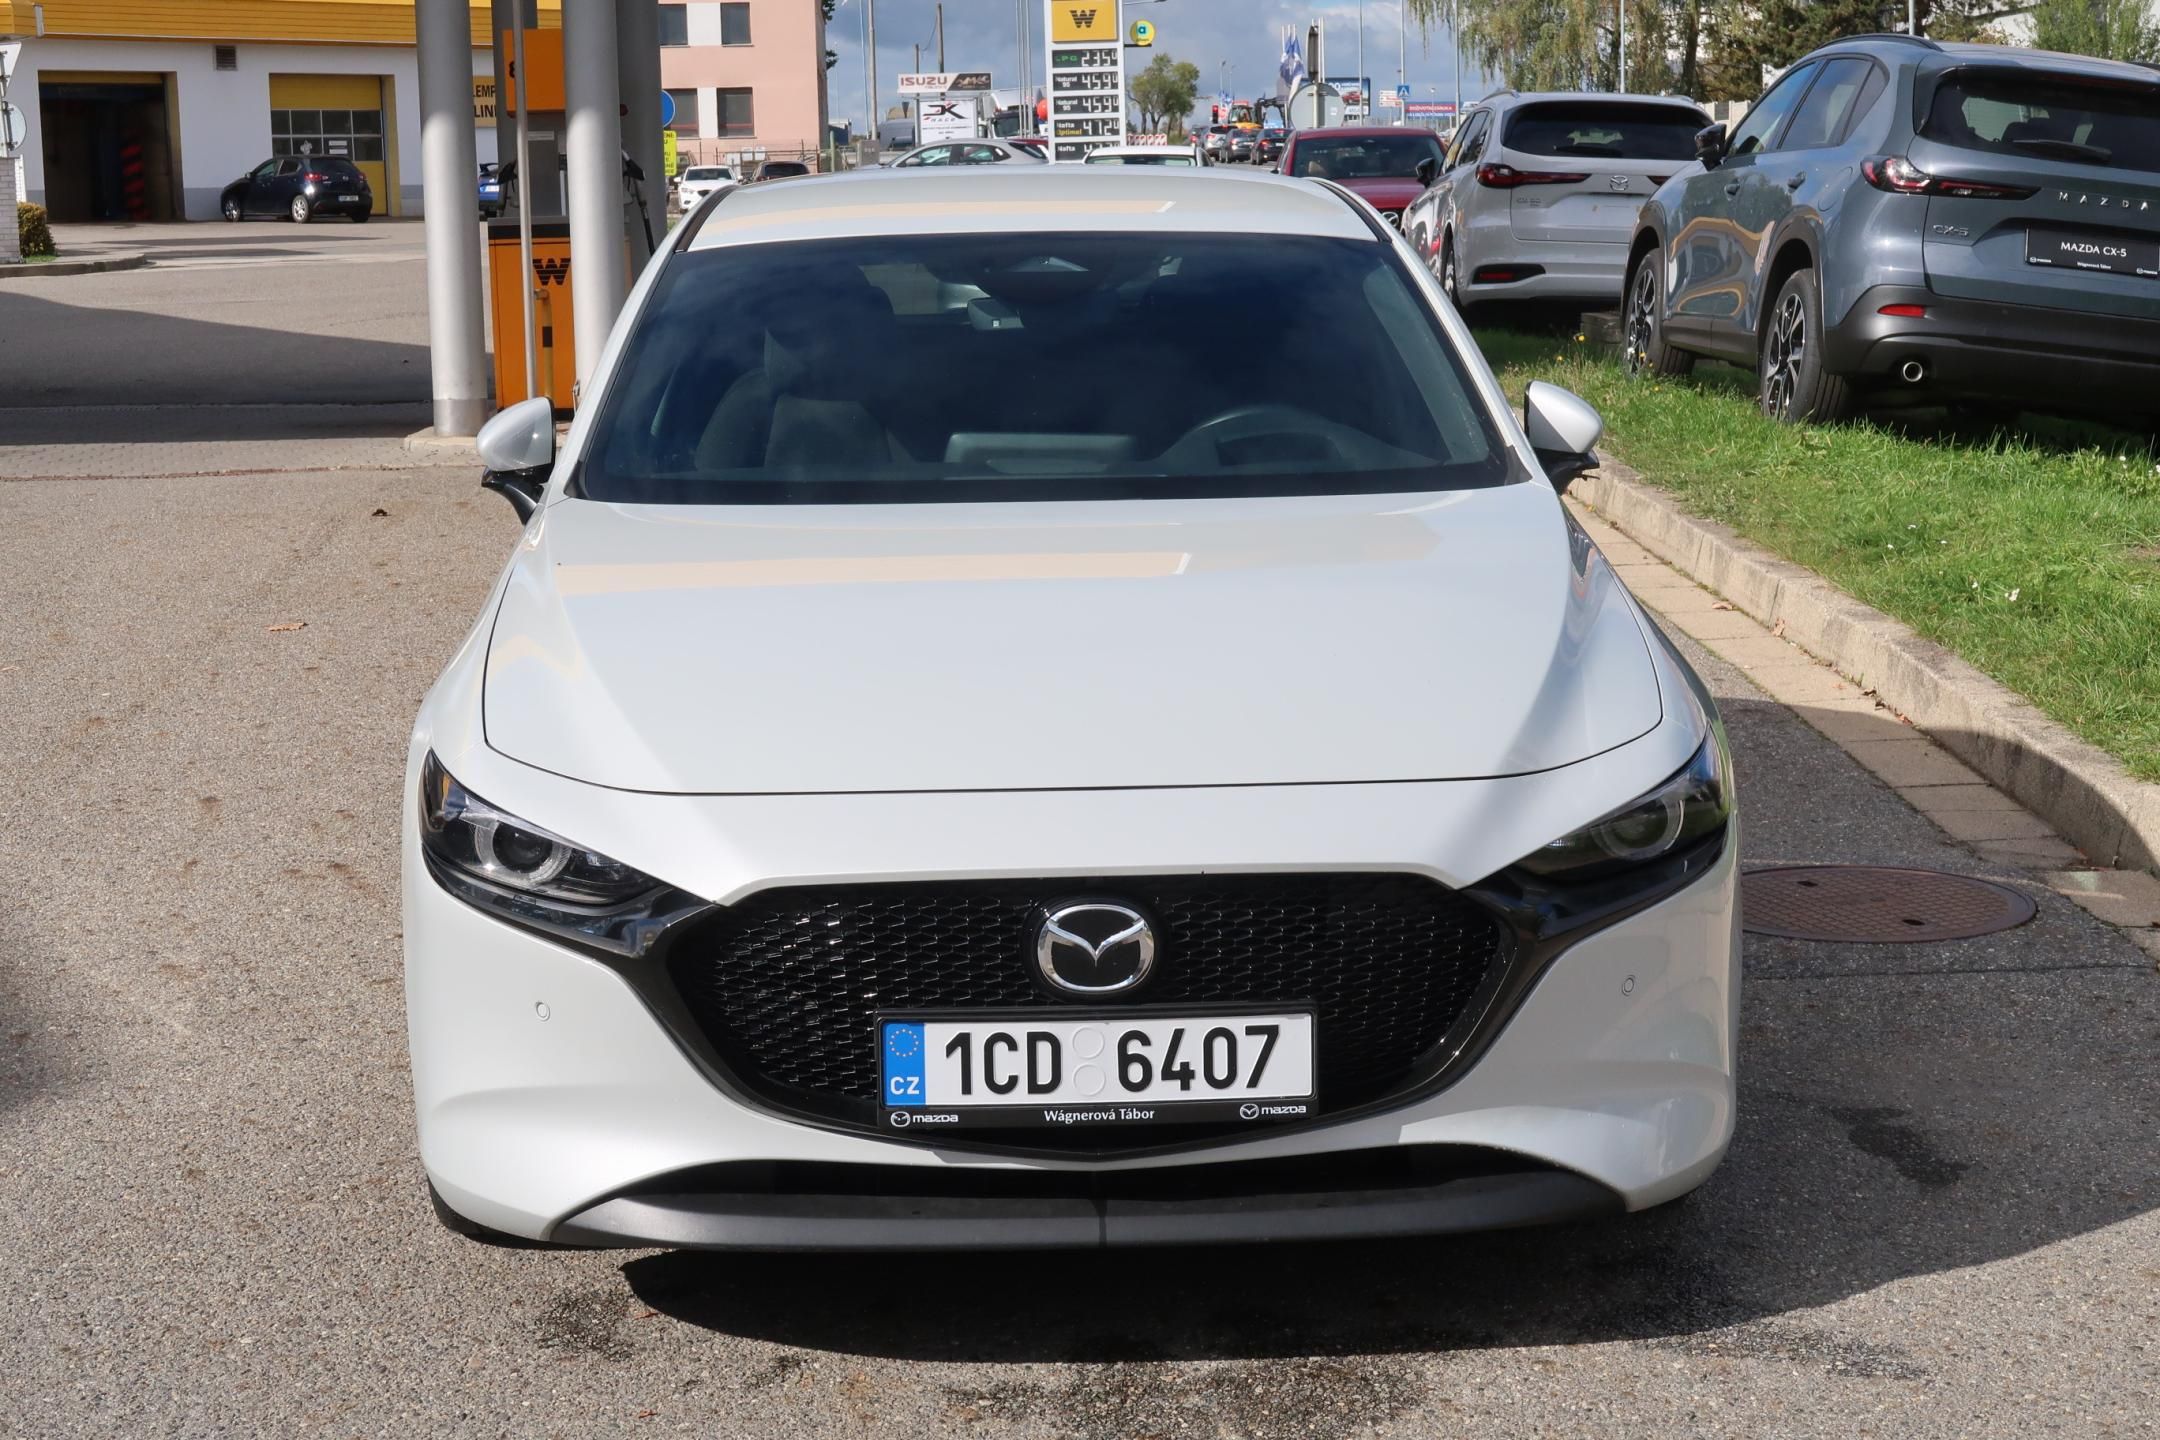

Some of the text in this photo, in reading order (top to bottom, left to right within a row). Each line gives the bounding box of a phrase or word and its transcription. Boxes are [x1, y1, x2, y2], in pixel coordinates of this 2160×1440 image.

[901, 76, 948, 86] ISUZU
[472, 84, 497, 97] EMP
[2058, 192, 2149, 211] MAZDA
[2060, 242, 2127, 257] MAZDA CX-5
[945, 1024, 1280, 1096] 1CD 6407
[890, 1077, 920, 1095] CZ
[1044, 1108, 1155, 1125] Wágnerová Tábor
